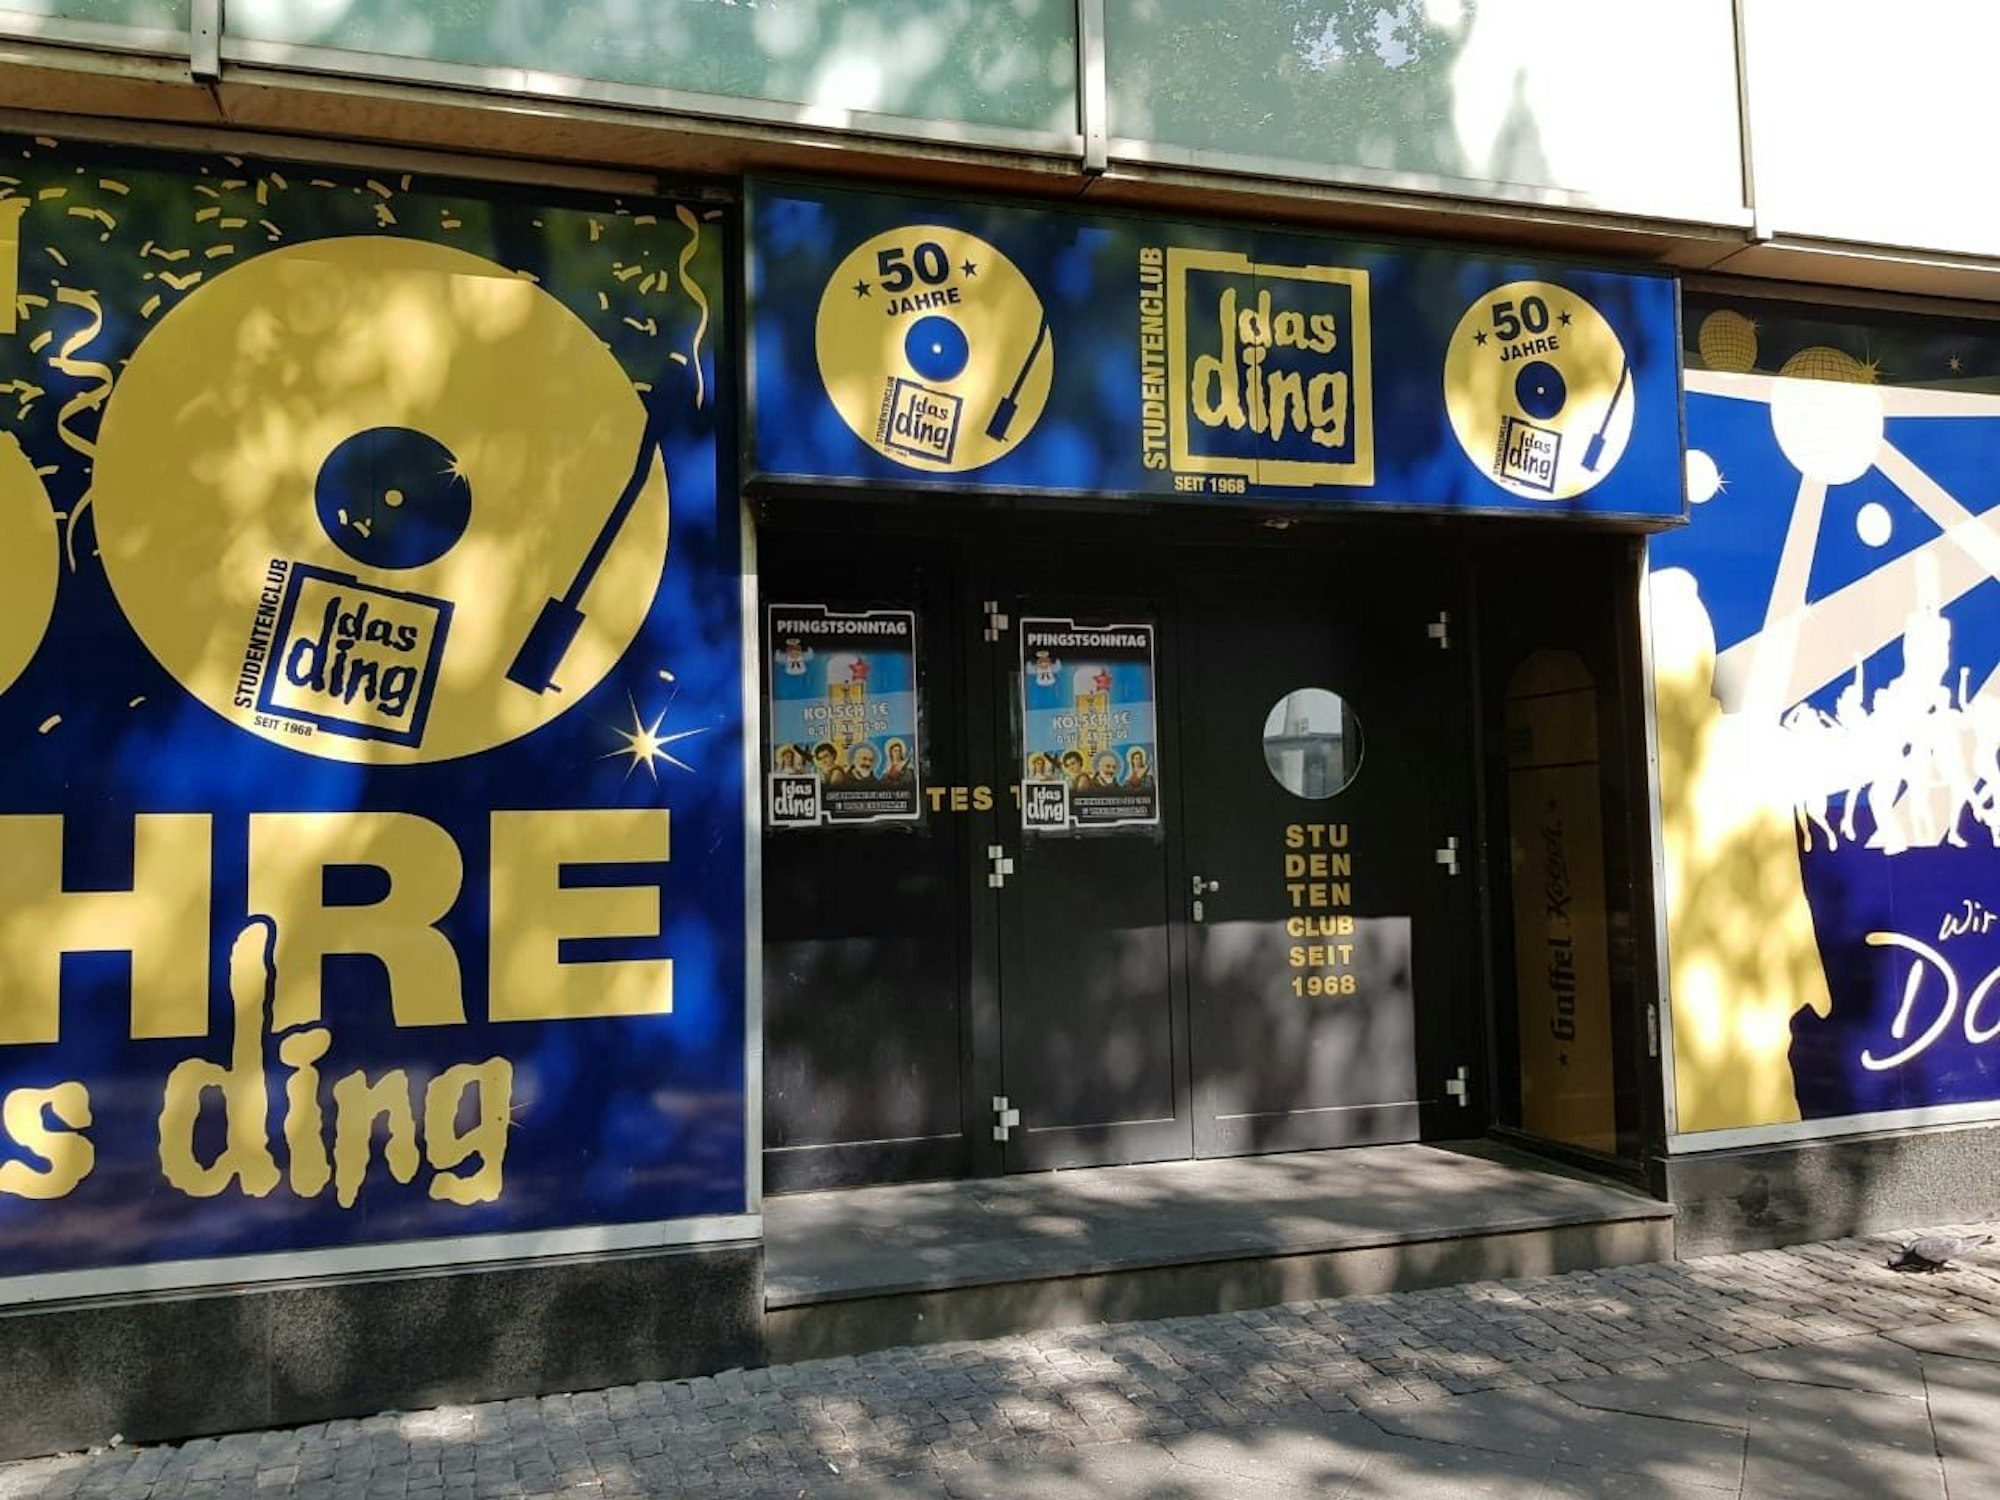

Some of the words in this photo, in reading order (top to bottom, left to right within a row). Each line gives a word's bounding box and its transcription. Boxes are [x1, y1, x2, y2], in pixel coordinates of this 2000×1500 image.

[876, 241, 949, 293] 50
[885, 285, 962, 317] JAHRE
[1239, 290, 1338, 353] das
[1490, 295, 1550, 343] 50
[1143, 246, 1166, 470] STUDENTENCLUB
[1499, 334, 1561, 363] JAHRE
[1191, 286, 1348, 448] ding
[895, 394, 949, 450] ding
[916, 397, 949, 420] das
[1509, 430, 1551, 480] ding
[1525, 433, 1551, 453] das
[1174, 475, 1204, 493] SEIT
[1207, 476, 1246, 495] 1968
[235, 558, 289, 708] STUDENTENCLUB
[337, 600, 417, 652] das
[776, 619, 907, 635] PFINGSTSONNTAG
[1027, 633, 1147, 648] PFINGSTSONNTAG
[286, 596, 417, 716] ding
[254, 715, 282, 733] SEIT
[283, 720, 313, 737] 1968
[774, 780, 815, 818] ding
[786, 780, 812, 796] das
[926, 785, 993, 812] TES
[1038, 786, 1061, 801] das
[1027, 786, 1063, 822] ding
[1285, 824, 1348, 849] STU
[1285, 854, 1351, 878] DEN
[1287, 884, 1351, 906] TEN
[1287, 915, 1354, 937] CLUB
[1290, 944, 1353, 967] SEIT
[1292, 975, 1355, 997] 1968
[1547, 936, 1576, 1041] Gaffel
[157, 922, 512, 1208] ding
